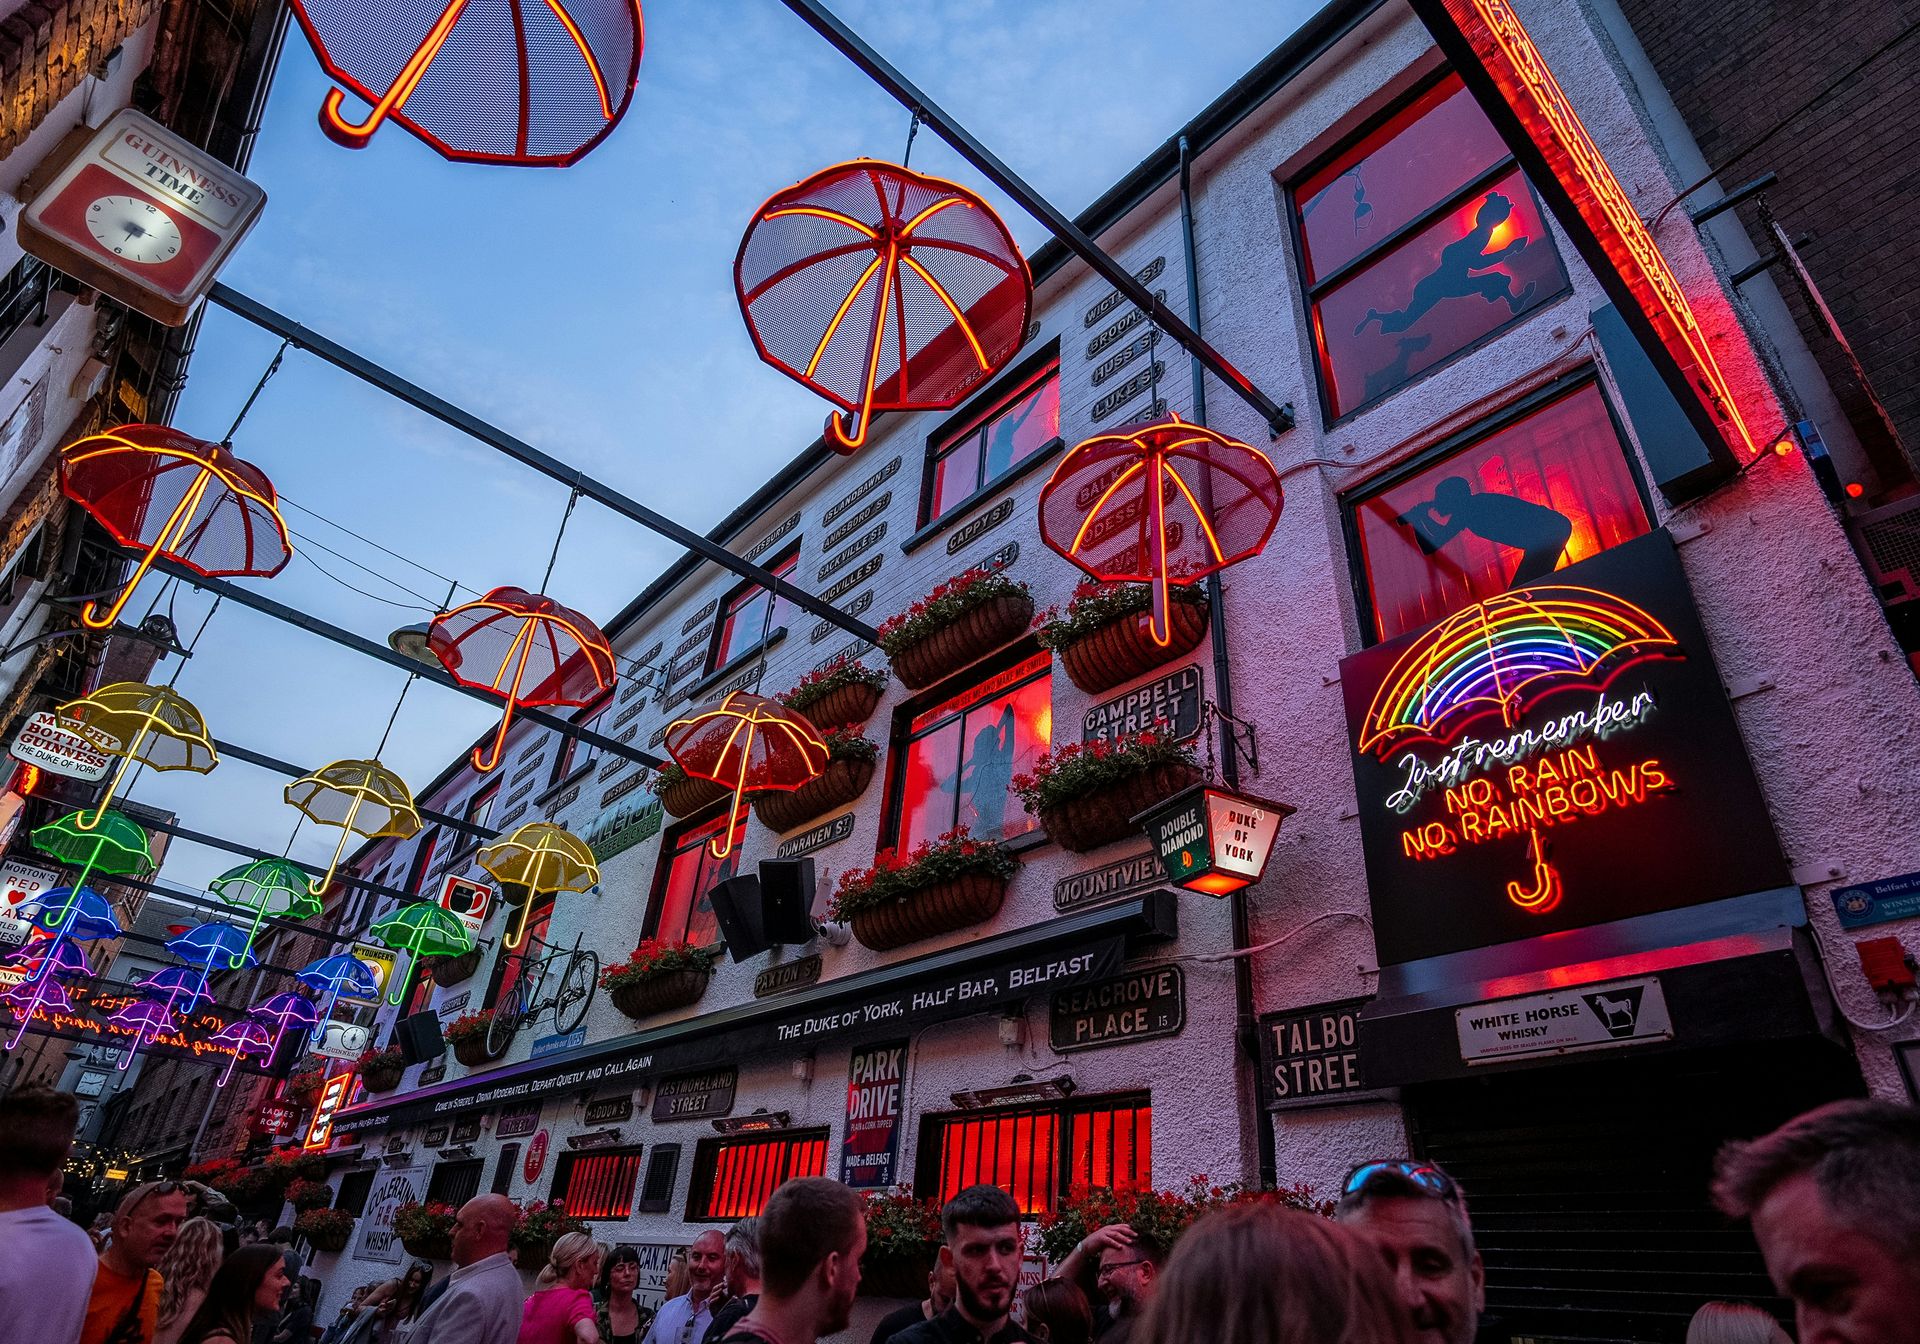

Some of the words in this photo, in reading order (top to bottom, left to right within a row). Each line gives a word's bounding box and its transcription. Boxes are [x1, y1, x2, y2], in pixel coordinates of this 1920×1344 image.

[125, 134, 241, 208] GUINNESS
[144, 162, 205, 205] TIME
[92, 204, 102, 212] 9
[145, 204, 157, 214] 12
[114, 246, 122, 254] 6
[167, 246, 176, 254] 3
[1095, 346, 1133, 379] HUSS
[1095, 379, 1137, 417] LUKE
[824, 472, 882, 522] ISLANDBAWN
[950, 514, 990, 549] CAPPY
[818, 535, 868, 578] SACKVILLE
[1085, 672, 1195, 731] CAMPBELL
[1097, 696, 1183, 742] STREET
[1474, 682, 1655, 769] remember
[17, 742, 36, 756] THE
[35, 750, 60, 765] DUKE
[60, 759, 74, 769] OF
[76, 762, 100, 776] YORK
[20, 734, 107, 768] GUINNESS
[1446, 778, 1491, 814] NO
[1508, 743, 1597, 793] RAIN
[1161, 808, 1196, 838] DOUBLE
[1229, 810, 1257, 830] DUKE
[1402, 822, 1445, 858] NO
[1461, 759, 1666, 840] RAINBOWS
[598, 836, 622, 857] STEEL
[622, 818, 658, 844] BICYCLE
[778, 825, 832, 858] DUNRAVEN
[1161, 822, 1204, 857] DIAMOND
[1225, 843, 1254, 863] YORK
[1234, 829, 1248, 844] OF
[4, 864, 56, 882] MORTON'S
[6, 876, 40, 891] RED
[1874, 882, 1910, 894] Belfast
[755, 962, 800, 991] PAXTON
[778, 1022, 802, 1041] THE
[804, 1016, 839, 1035] DUKE
[842, 1012, 858, 1026] OF
[864, 1000, 904, 1022] YORK,
[912, 987, 955, 1012] HALF
[958, 977, 998, 1001] BAP,
[1009, 954, 1094, 990] BELFAST
[1058, 973, 1172, 1015] SEAGROVE
[1074, 1008, 1148, 1042] PLACE
[1158, 1014, 1168, 1027] 15
[1272, 1012, 1361, 1057] TALBO
[1470, 1012, 1520, 1031] WHITE
[1525, 1004, 1580, 1022] HORSE
[1498, 1026, 1548, 1042] WHISKY
[530, 1077, 557, 1092] DEPART
[556, 1071, 586, 1087] QUIETLY
[586, 1068, 602, 1081] AND
[604, 1062, 624, 1076] CALL
[624, 1056, 653, 1072] AGAIN
[852, 1048, 902, 1085] PARK
[658, 1072, 733, 1097] WESTMORELAND
[261, 1106, 294, 1118] LADIES
[670, 1094, 708, 1114] STREET
[850, 1083, 900, 1121] DRIVE
[260, 1118, 289, 1129] ROOM
[846, 1155, 861, 1168] MADE
[865, 1152, 890, 1167] BELFAST
